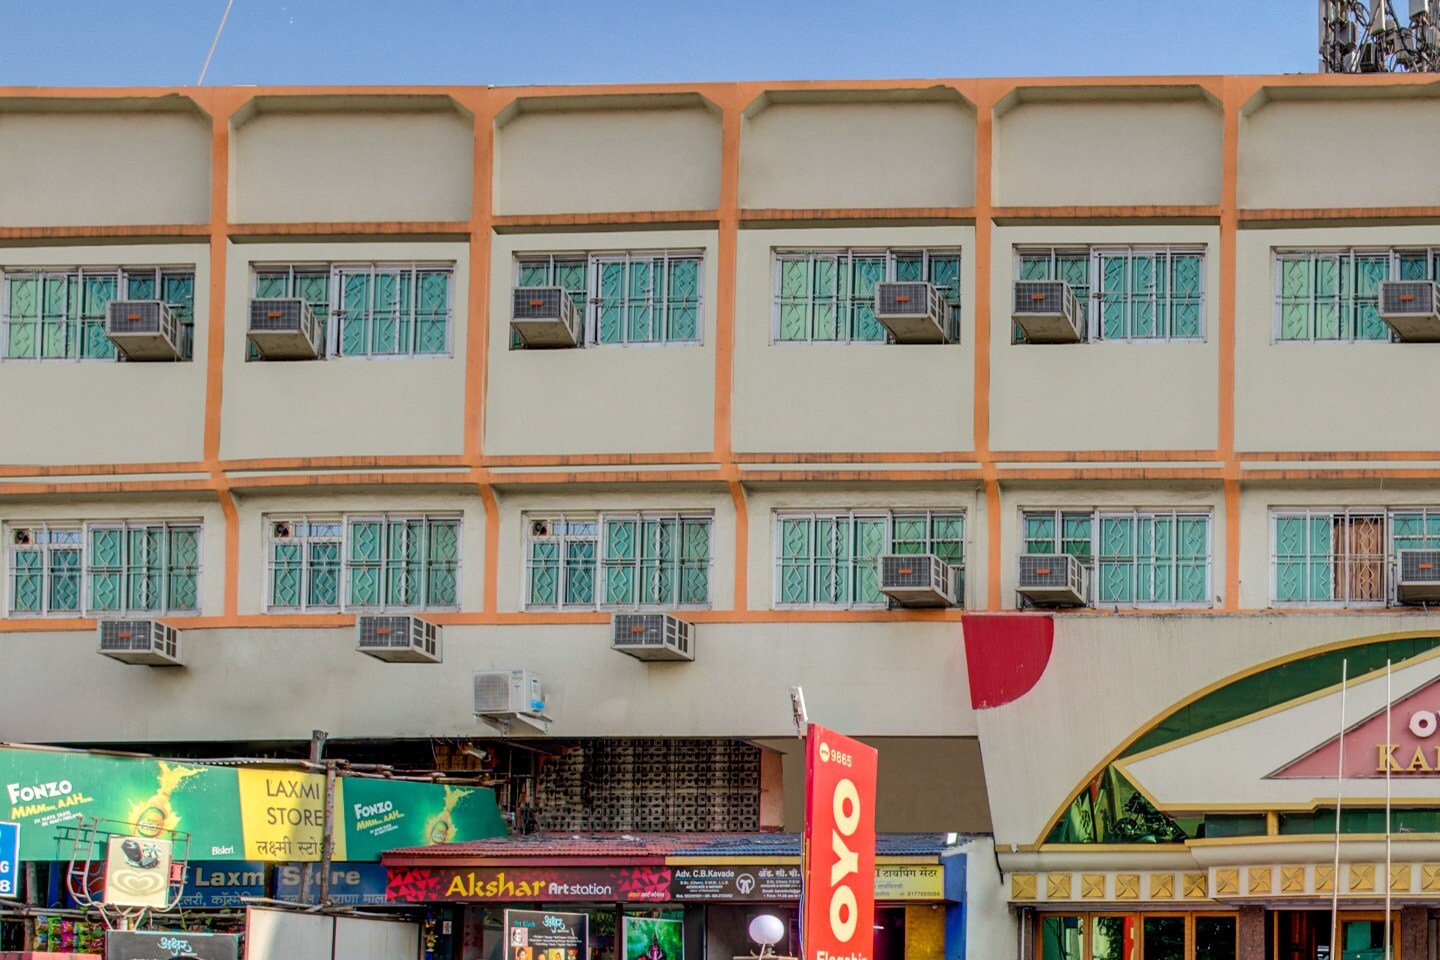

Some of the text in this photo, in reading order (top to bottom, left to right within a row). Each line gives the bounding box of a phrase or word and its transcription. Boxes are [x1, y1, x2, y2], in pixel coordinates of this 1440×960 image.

[7, 780, 72, 804] FONZO
[266, 779, 320, 799] LAXMI
[267, 806, 324, 826] STORE
[256, 837, 291, 856] लक्ष्मी
[829, 778, 861, 943] OYO
[196, 866, 361, 886] Laxm Sore
[675, 869, 692, 878] Adv.
[882, 866, 916, 878] टायपिंग
[445, 872, 546, 898] Akshar
[548, 883, 612, 895] Art station
